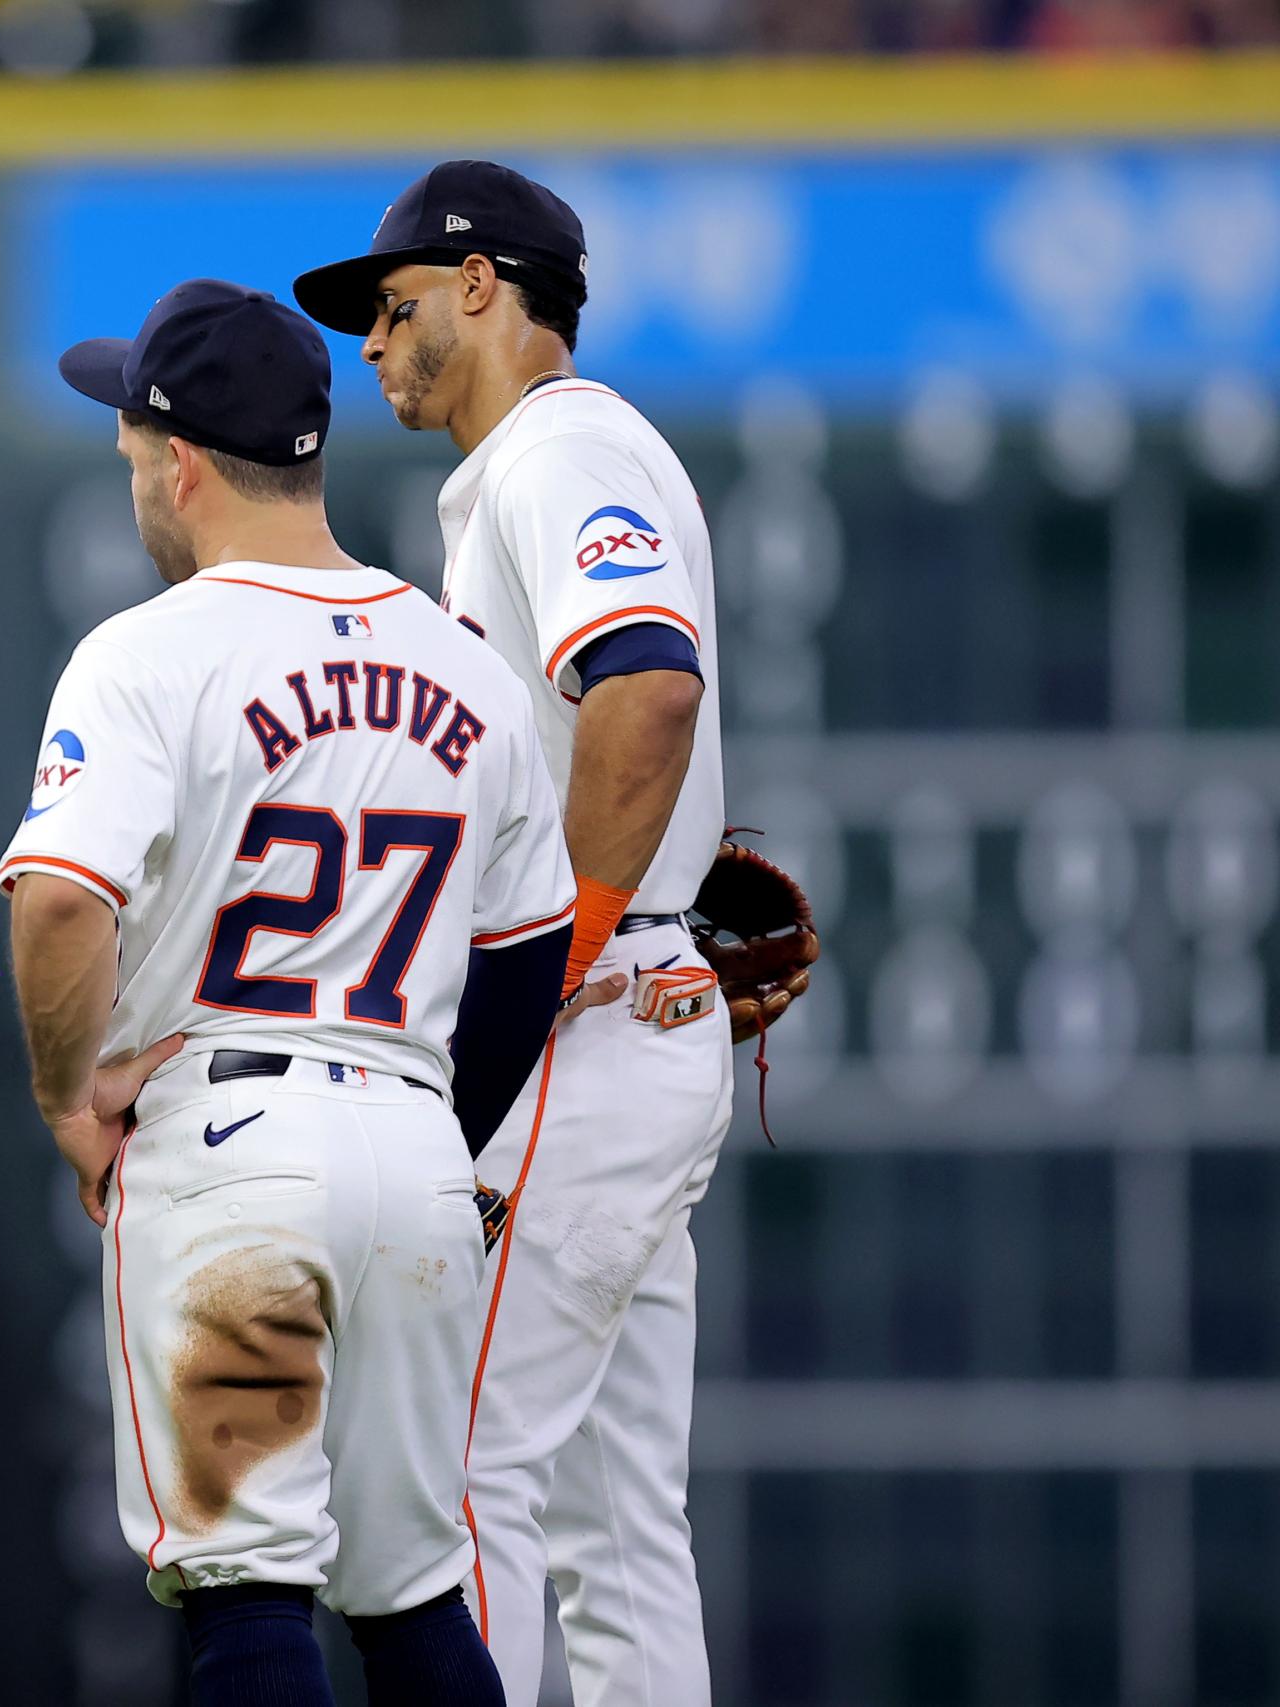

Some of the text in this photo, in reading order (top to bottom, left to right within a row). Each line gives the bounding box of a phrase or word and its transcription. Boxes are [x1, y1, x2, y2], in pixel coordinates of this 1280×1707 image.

[577, 532, 663, 570] OXY
[243, 660, 486, 778] ALTUVE
[33, 764, 82, 788] XY
[192, 802, 467, 1030] 27
